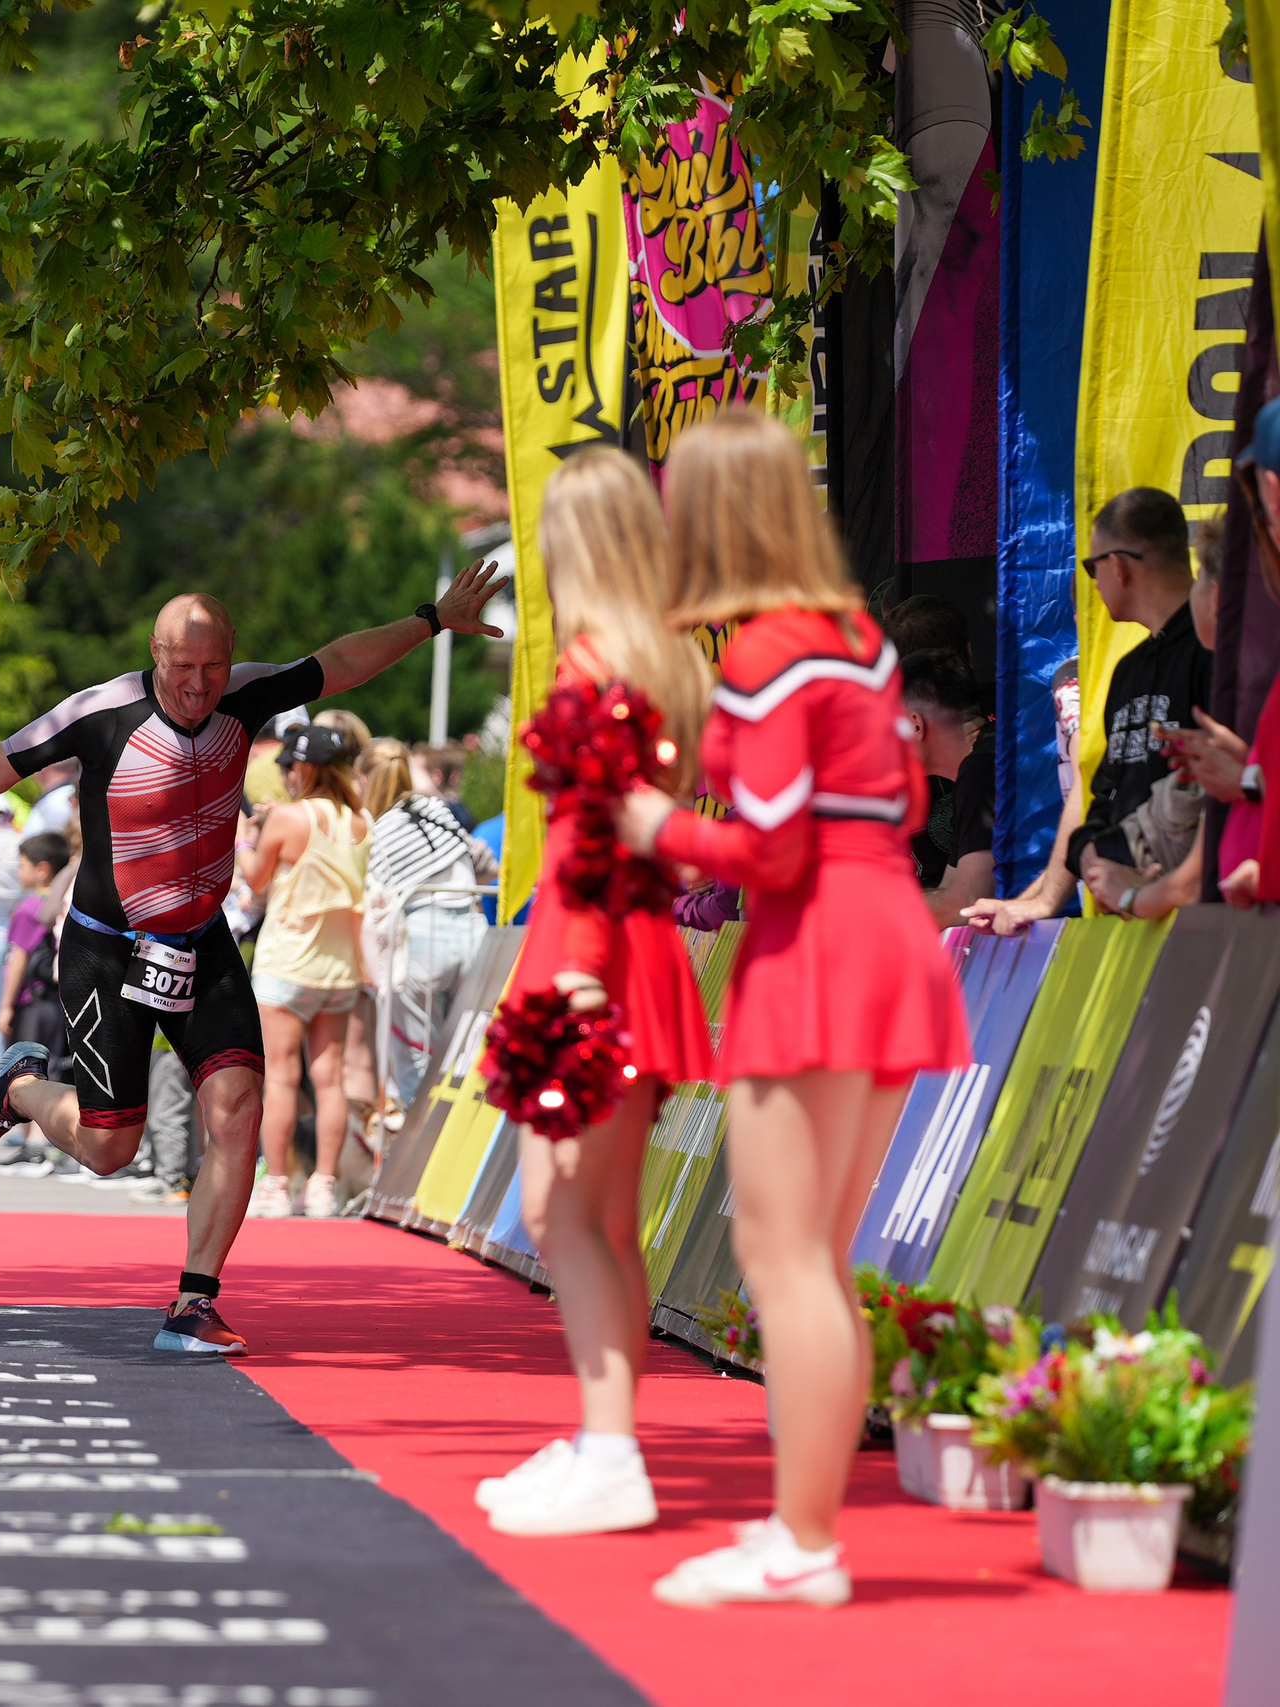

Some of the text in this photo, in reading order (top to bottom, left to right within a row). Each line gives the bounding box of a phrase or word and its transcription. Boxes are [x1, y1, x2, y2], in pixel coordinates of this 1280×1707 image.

[529, 213, 578, 404] STAR
[178, 956, 191, 964] STAR
[141, 965, 194, 996] 3071
[153, 996, 177, 1008] VITALIY
